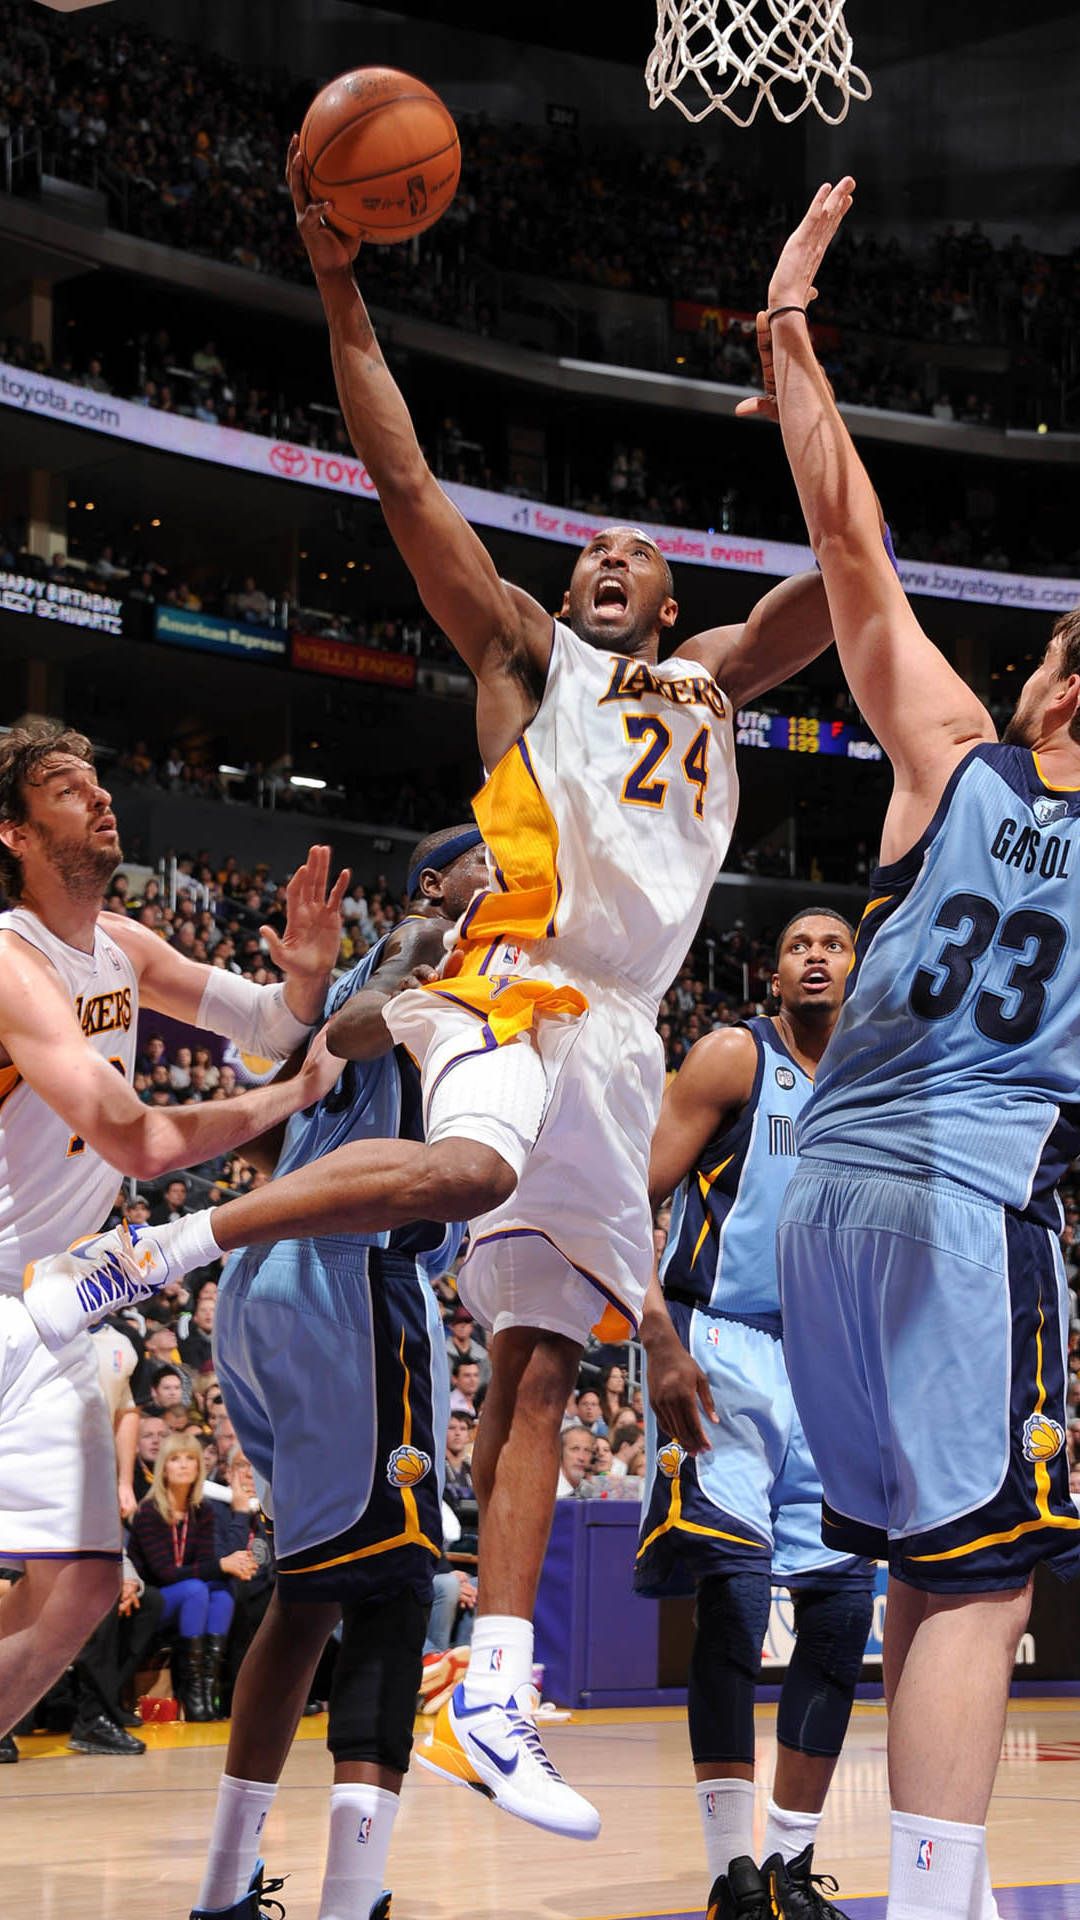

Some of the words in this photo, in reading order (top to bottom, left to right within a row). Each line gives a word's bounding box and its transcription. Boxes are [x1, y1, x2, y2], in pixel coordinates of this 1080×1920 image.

[311, 456, 377, 491] TOYO
[534, 511, 560, 534] for
[655, 535, 705, 558] sales
[711, 545, 765, 567] event
[157, 614, 227, 643] American
[229, 628, 286, 654] Express
[598, 656, 726, 720] LAKERS
[736, 711, 771, 731] UTA
[831, 721, 844, 738] F
[736, 729, 771, 748] ATL
[619, 713, 712, 822] 24
[990, 818, 1072, 879] GASOL
[908, 888, 1070, 1046] 33
